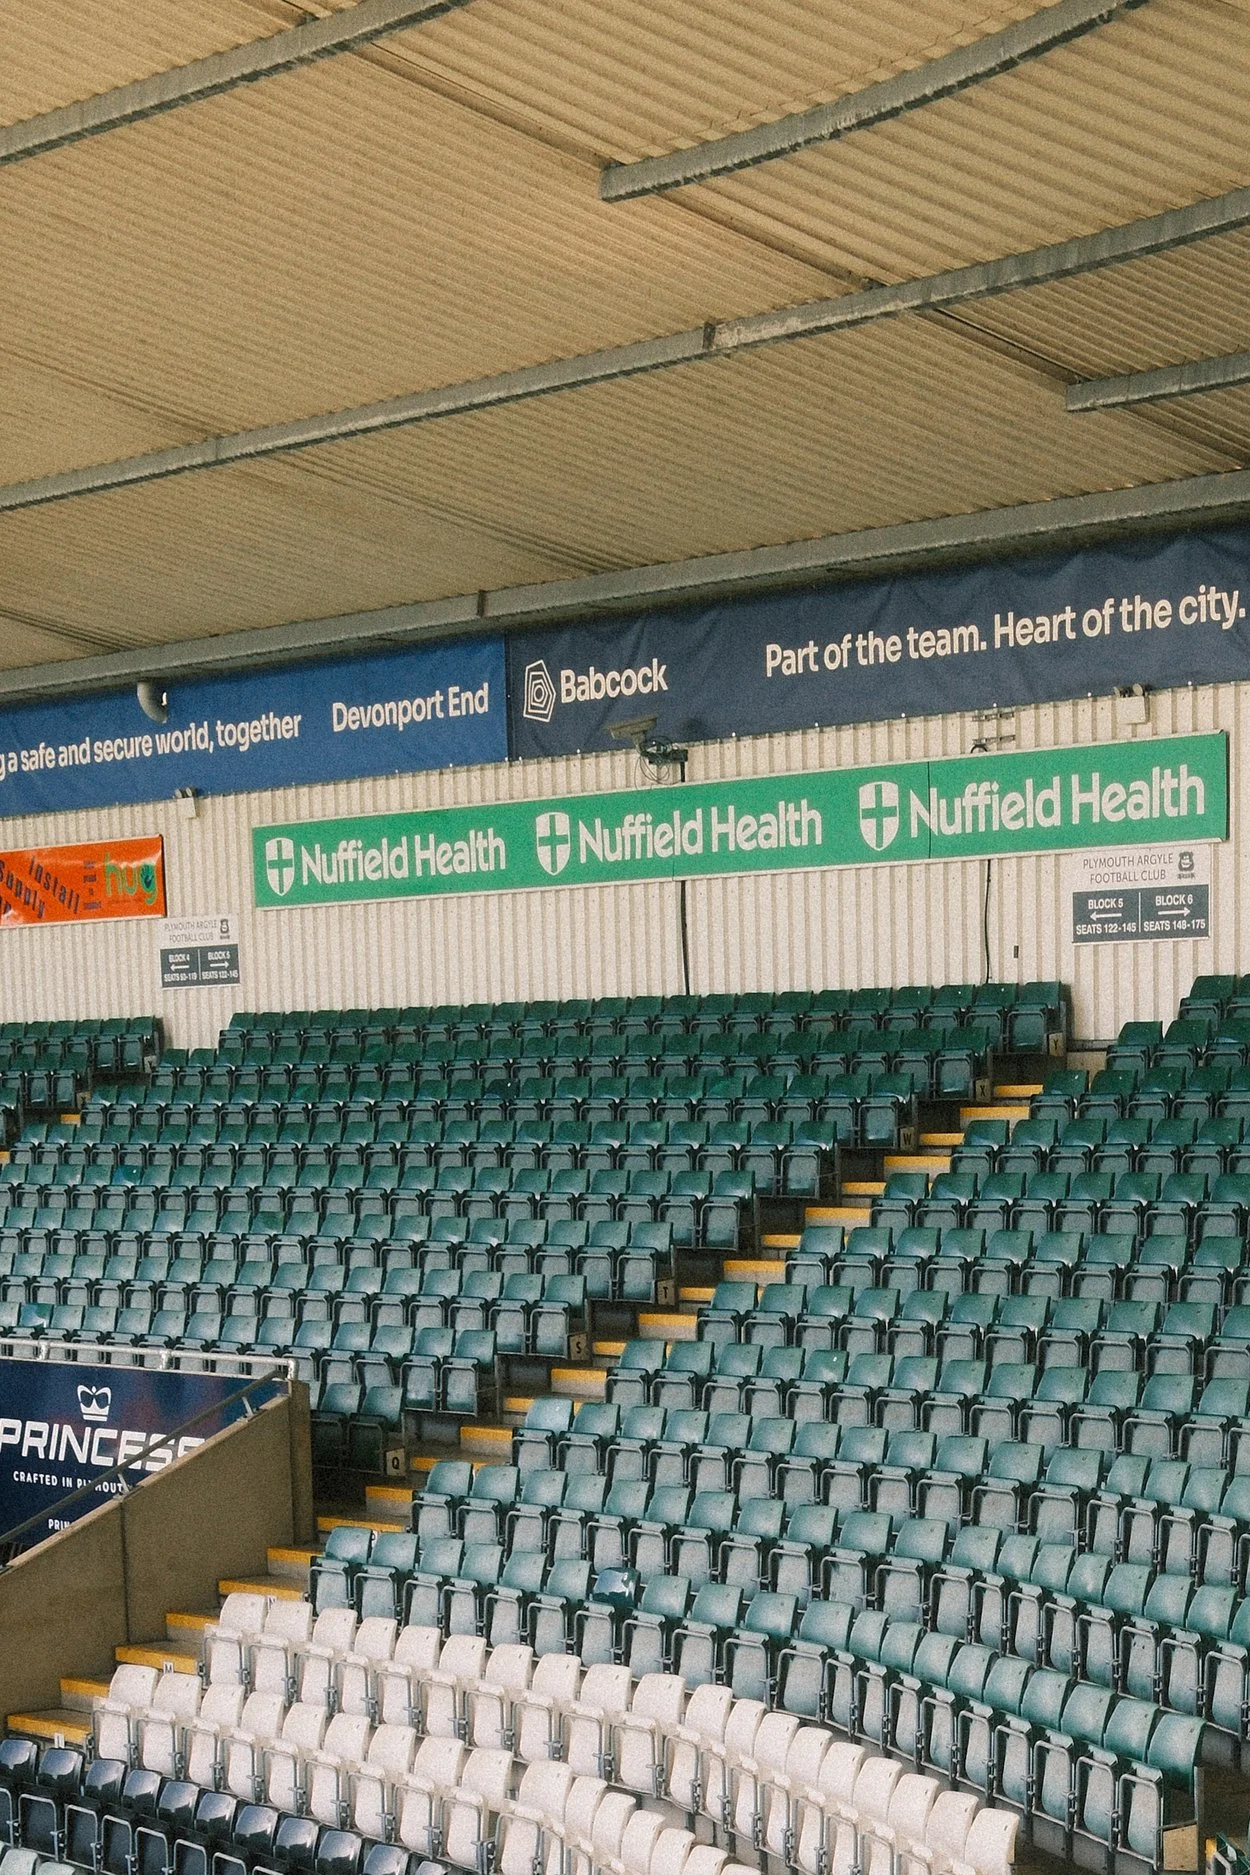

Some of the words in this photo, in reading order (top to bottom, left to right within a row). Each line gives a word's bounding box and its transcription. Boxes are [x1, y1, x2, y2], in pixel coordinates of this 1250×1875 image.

[765, 641, 820, 677] Part
[823, 633, 853, 671] of
[856, 627, 903, 664] the
[906, 622, 988, 660] team.
[993, 605, 1077, 651] Heart
[1081, 598, 1115, 637] of
[1115, 592, 1174, 632] the
[1179, 583, 1248, 631] city.
[559, 657, 670, 704] Babcock
[331, 689, 445, 734] Devonport
[448, 682, 490, 717] End
[8, 753, 18, 773] a
[21, 742, 55, 771] safe
[58, 737, 91, 766] and
[93, 733, 153, 763] secure
[155, 720, 214, 754] world,
[215, 711, 303, 752] together
[908, 774, 1065, 840] Nuffield
[1071, 763, 1206, 827] Health
[578, 802, 705, 865] Nuffield
[710, 797, 823, 854] Health
[301, 831, 409, 885] Nuffield
[414, 826, 507, 877] Health
[1083, 856, 1135, 870] PLYMOUTH
[1137, 853, 1174, 866] ARGYLE
[105, 852, 158, 906] hug
[1090, 872, 1139, 885] FOOTBALL
[1140, 869, 1167, 881] CLUB
[1087, 898, 1117, 910] BLOCK
[1118, 898, 1124, 909] 5
[1155, 895, 1186, 907] BLOCK
[1187, 894, 1193, 905] 6
[1076, 923, 1103, 936] SEATS
[1104, 922, 1137, 934] 122-145
[1143, 920, 1171, 932] SEATS
[1172, 918, 1206, 930] 148-175
[1053, 1039, 1060, 1051] Y
[979, 1084, 986, 1097] X
[902, 1133, 912, 1146] W
[662, 1287, 670, 1299] T
[575, 1341, 582, 1355] S
[391, 1456, 400, 1470] Q
[13, 1470, 58, 1486] CRAFTED
[62, 1476, 73, 1488] IN
